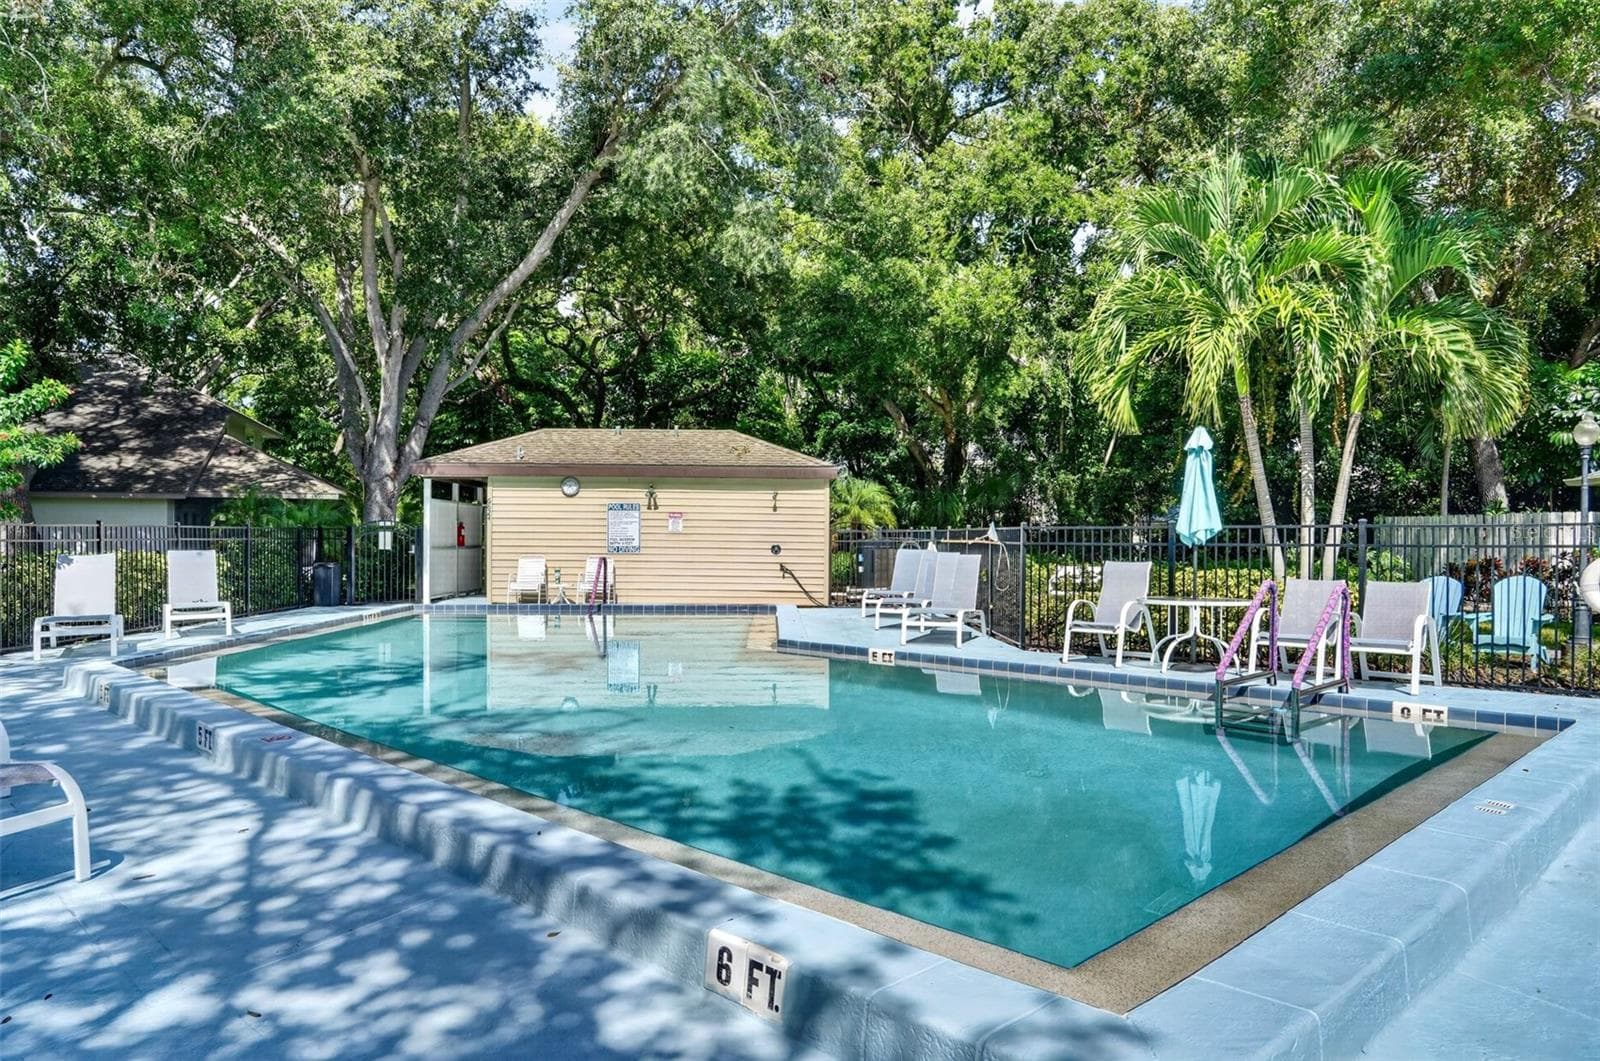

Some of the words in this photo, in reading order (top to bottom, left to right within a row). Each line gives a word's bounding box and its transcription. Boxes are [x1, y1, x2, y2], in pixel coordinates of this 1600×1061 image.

[608, 503, 622, 511] POOL
[198, 726, 203, 746] 5
[716, 945, 733, 987] 6
